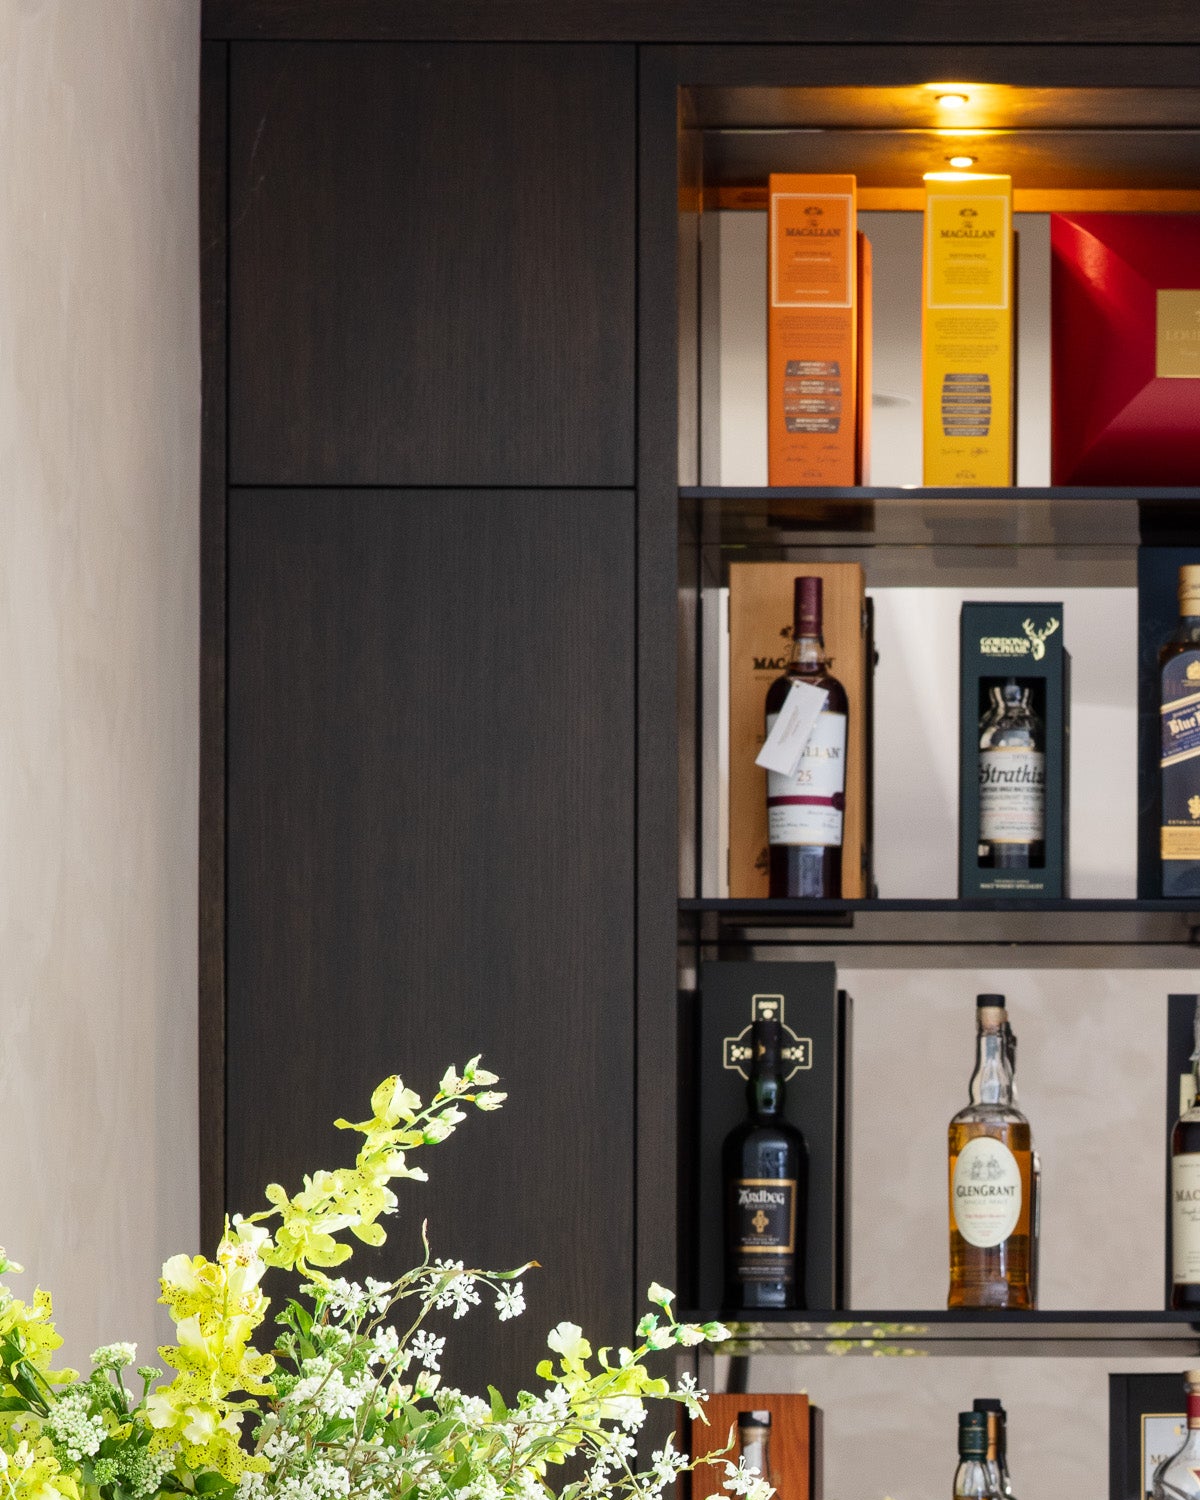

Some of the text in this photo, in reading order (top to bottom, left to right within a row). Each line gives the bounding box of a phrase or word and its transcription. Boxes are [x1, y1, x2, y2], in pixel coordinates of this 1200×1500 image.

[940, 230, 996, 238] MACALLAN
[1167, 717, 1197, 736] Blue
[797, 770, 813, 782] 25
[739, 1189, 785, 1206] Ardbeg
